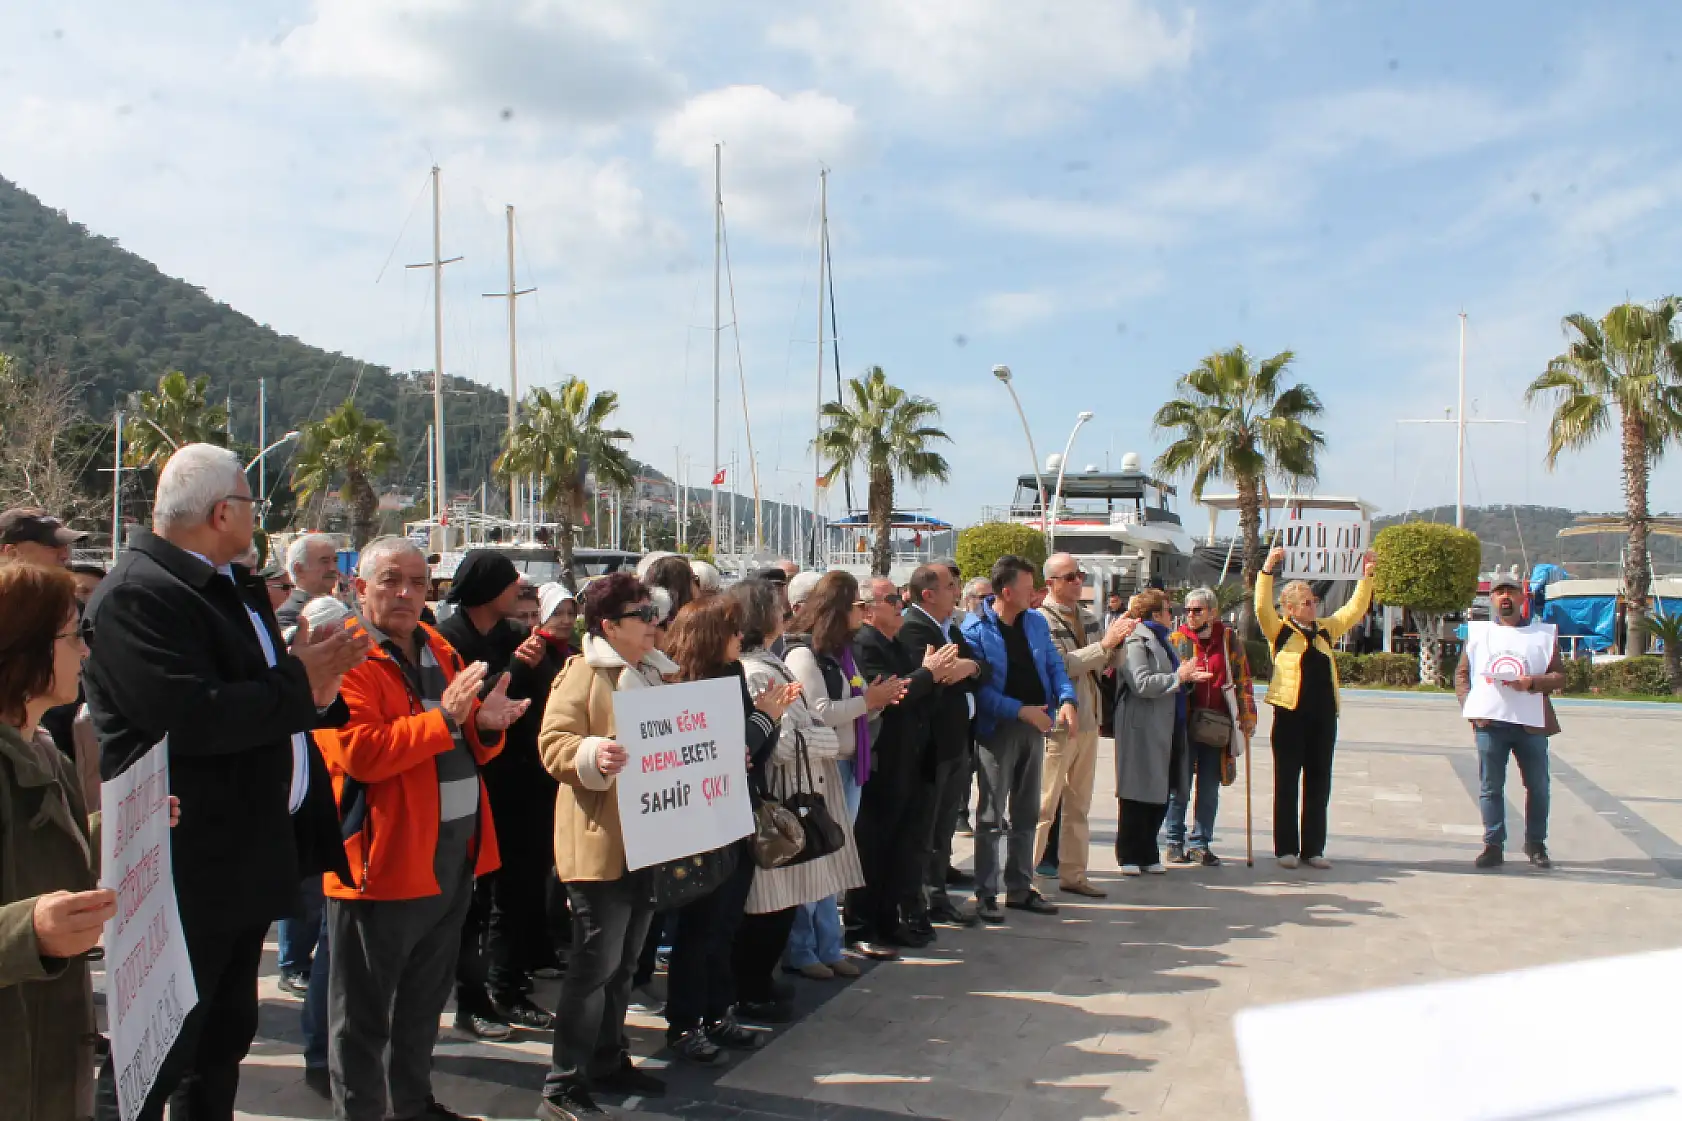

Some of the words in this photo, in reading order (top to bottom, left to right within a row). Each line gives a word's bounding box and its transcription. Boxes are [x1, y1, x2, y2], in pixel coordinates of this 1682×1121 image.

[676, 709, 708, 732] EĞME
[641, 740, 718, 773] MEMLEKETE
[640, 780, 691, 814] SAHİP
